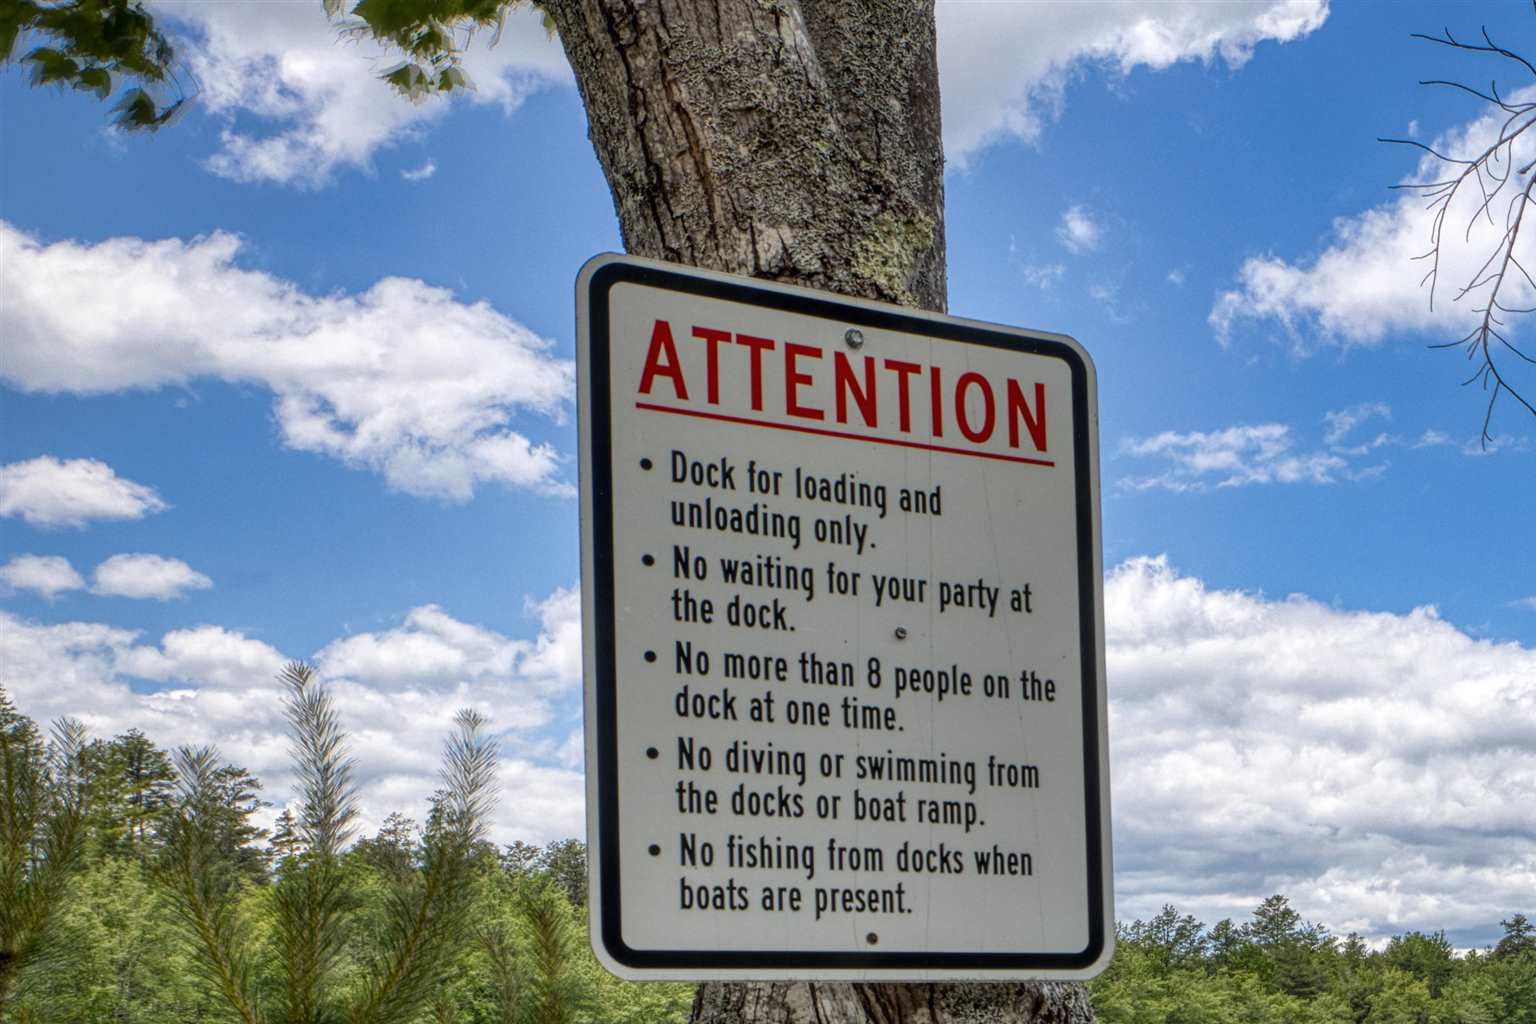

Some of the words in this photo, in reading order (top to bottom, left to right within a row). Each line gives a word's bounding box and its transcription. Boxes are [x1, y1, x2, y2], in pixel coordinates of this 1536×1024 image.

[638, 320, 1046, 452] ATTENTION
[672, 450, 736, 490] Dock
[747, 461, 782, 496] for
[796, 467, 886, 519] loading
[899, 486, 941, 516] and
[671, 497, 800, 550] unloading
[815, 515, 875, 555] only.
[671, 588, 714, 624] the
[727, 595, 795, 631] dock.
[674, 545, 707, 581] No
[720, 555, 814, 601] waiting
[827, 562, 860, 596] for
[872, 575, 927, 607] your
[939, 578, 999, 618] party
[1010, 584, 1032, 613] at
[676, 641, 709, 676] No
[724, 653, 787, 682] more
[798, 652, 854, 687] than
[868, 657, 881, 689] 8
[895, 665, 972, 702] people
[984, 675, 1009, 699] on
[1020, 670, 1055, 702] the
[675, 685, 737, 720] dock
[750, 691, 774, 723] at
[787, 700, 830, 726] one
[841, 697, 903, 731] time.
[678, 737, 711, 771] No
[726, 741, 806, 786] diving
[820, 754, 844, 778] or
[856, 753, 976, 795] swimming
[988, 755, 1039, 788] from
[675, 781, 718, 814] the
[732, 784, 804, 818] docks
[817, 795, 840, 819] or
[854, 789, 906, 822] boat
[918, 800, 984, 833] ramp.
[680, 833, 714, 867] No
[727, 835, 814, 880] fishing
[828, 838, 883, 871] from
[897, 841, 963, 874] docks
[974, 845, 1032, 876] when
[680, 877, 748, 911] boats
[762, 887, 801, 912] are
[815, 882, 912, 920] present.
